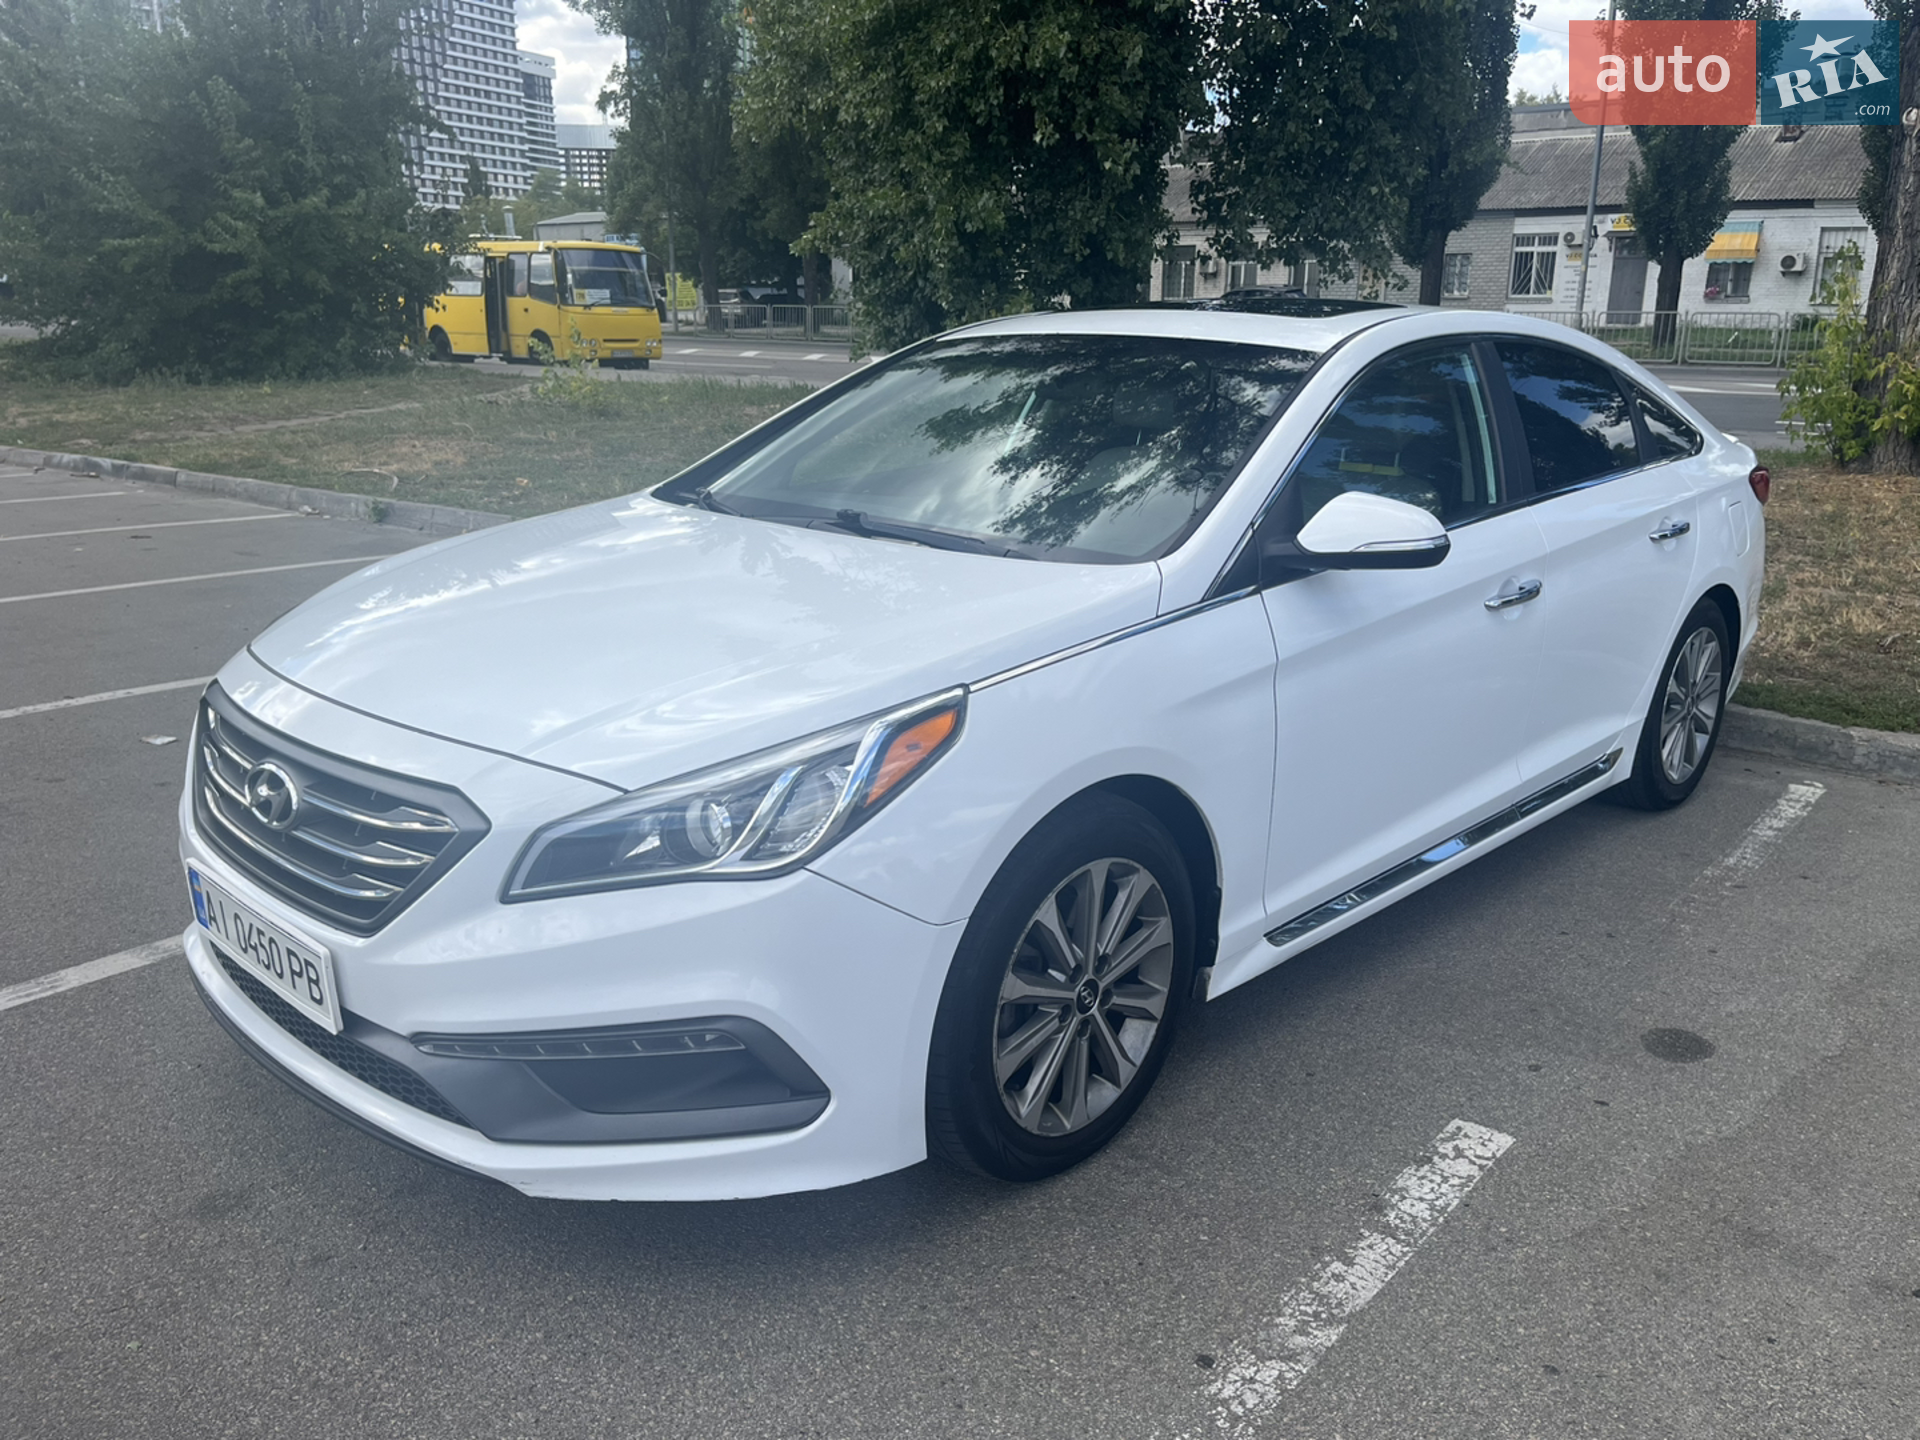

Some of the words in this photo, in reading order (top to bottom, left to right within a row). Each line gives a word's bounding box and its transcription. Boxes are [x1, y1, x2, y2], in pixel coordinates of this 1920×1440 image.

[205, 890, 230, 941] AI
[233, 912, 284, 980] 0450
[285, 946, 324, 1006] PB
